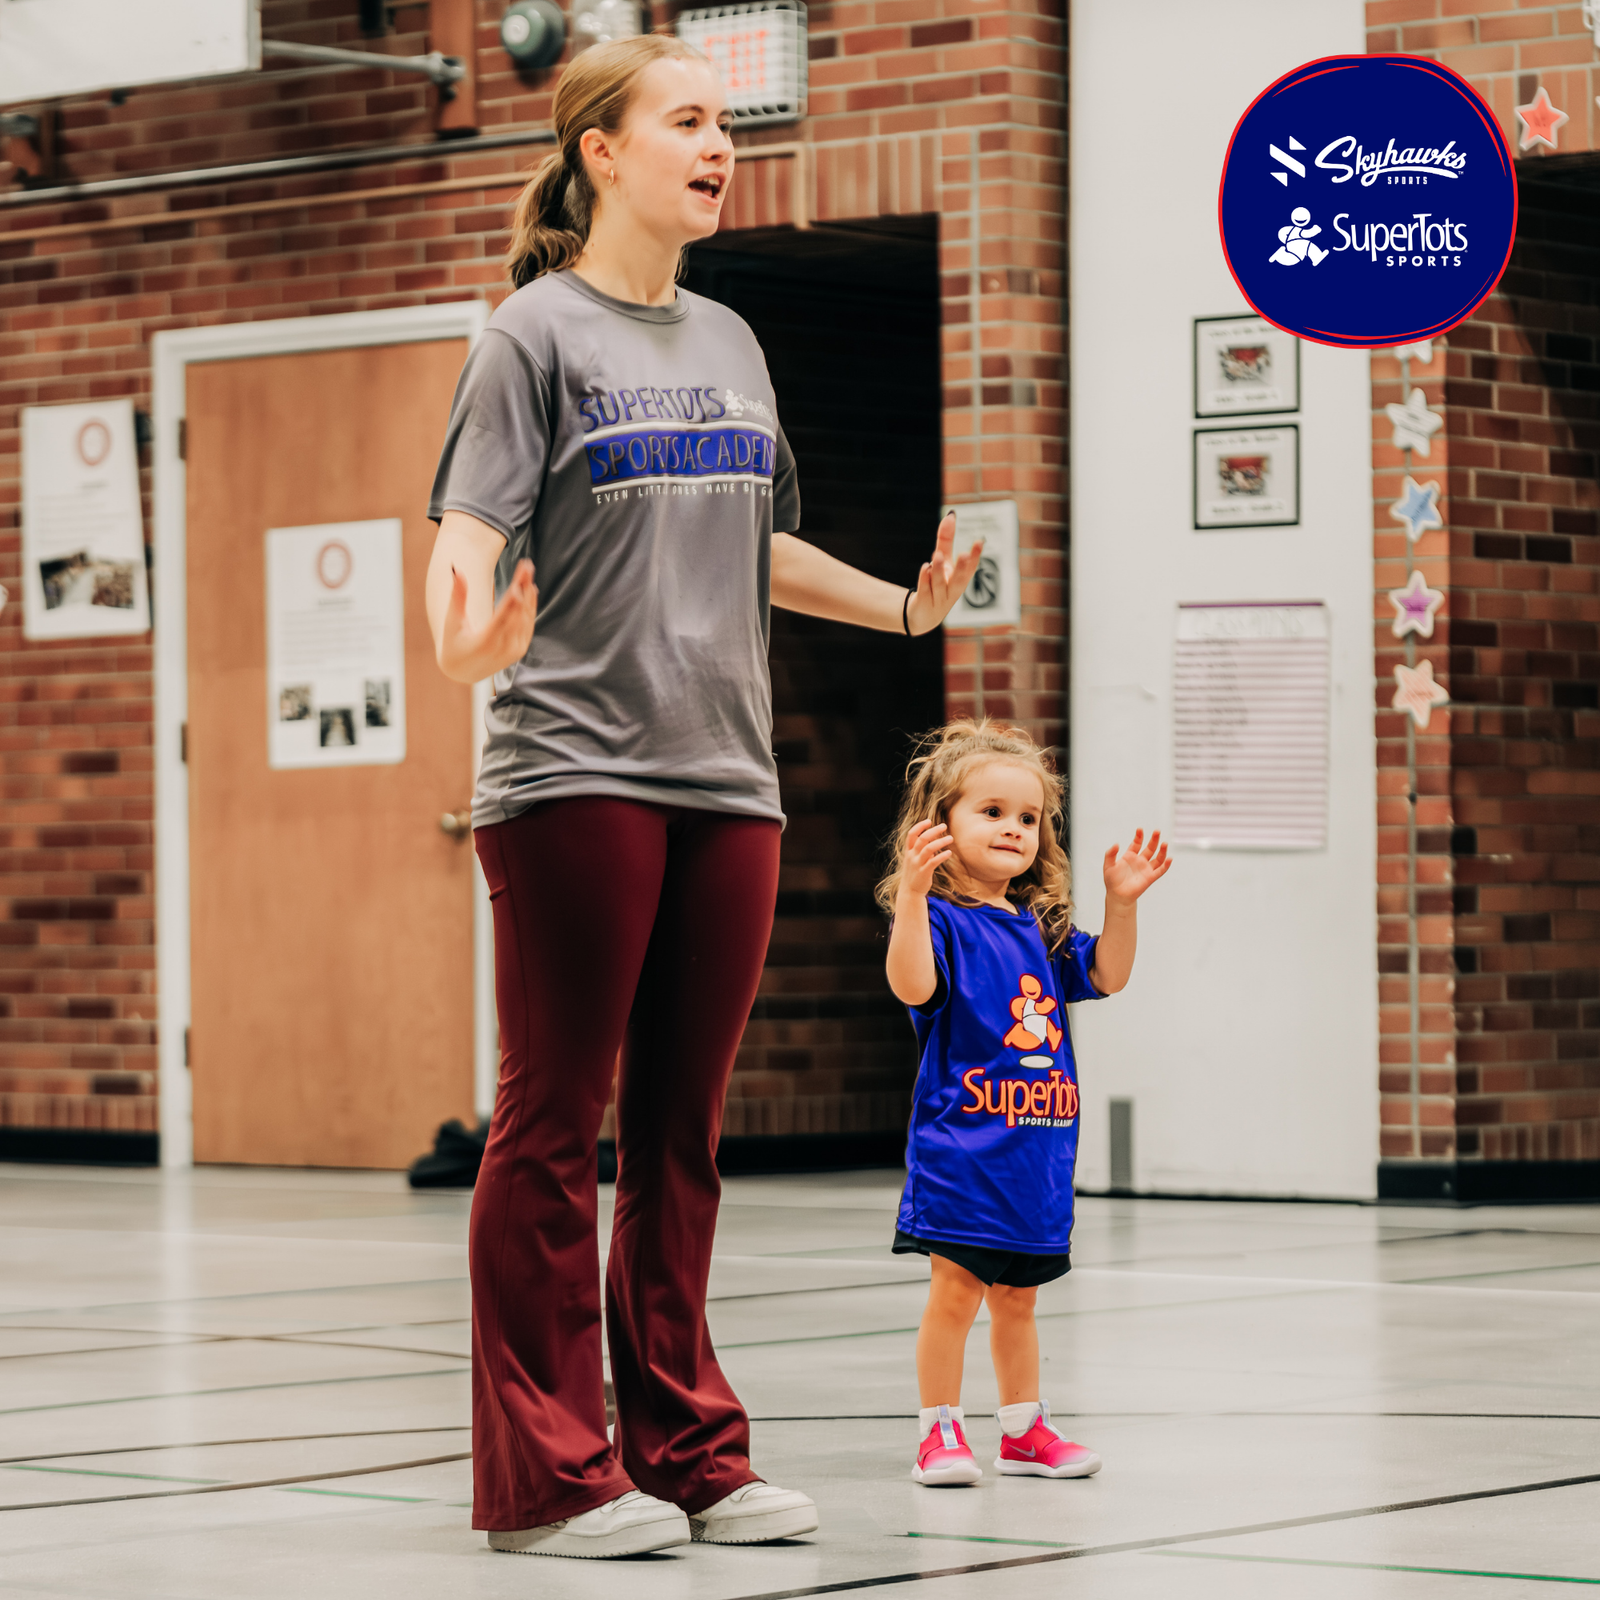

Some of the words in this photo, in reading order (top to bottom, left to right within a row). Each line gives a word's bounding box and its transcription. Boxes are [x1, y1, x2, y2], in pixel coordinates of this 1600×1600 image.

[579, 386, 726, 433] SUPERTOTS
[590, 434, 680, 480] SPORTS
[597, 489, 629, 505] EVEN
[638, 484, 668, 498] LITT
[672, 484, 698, 496] ONES
[706, 482, 735, 495] HAVE
[1017, 1116, 1052, 1128] SPORTS
